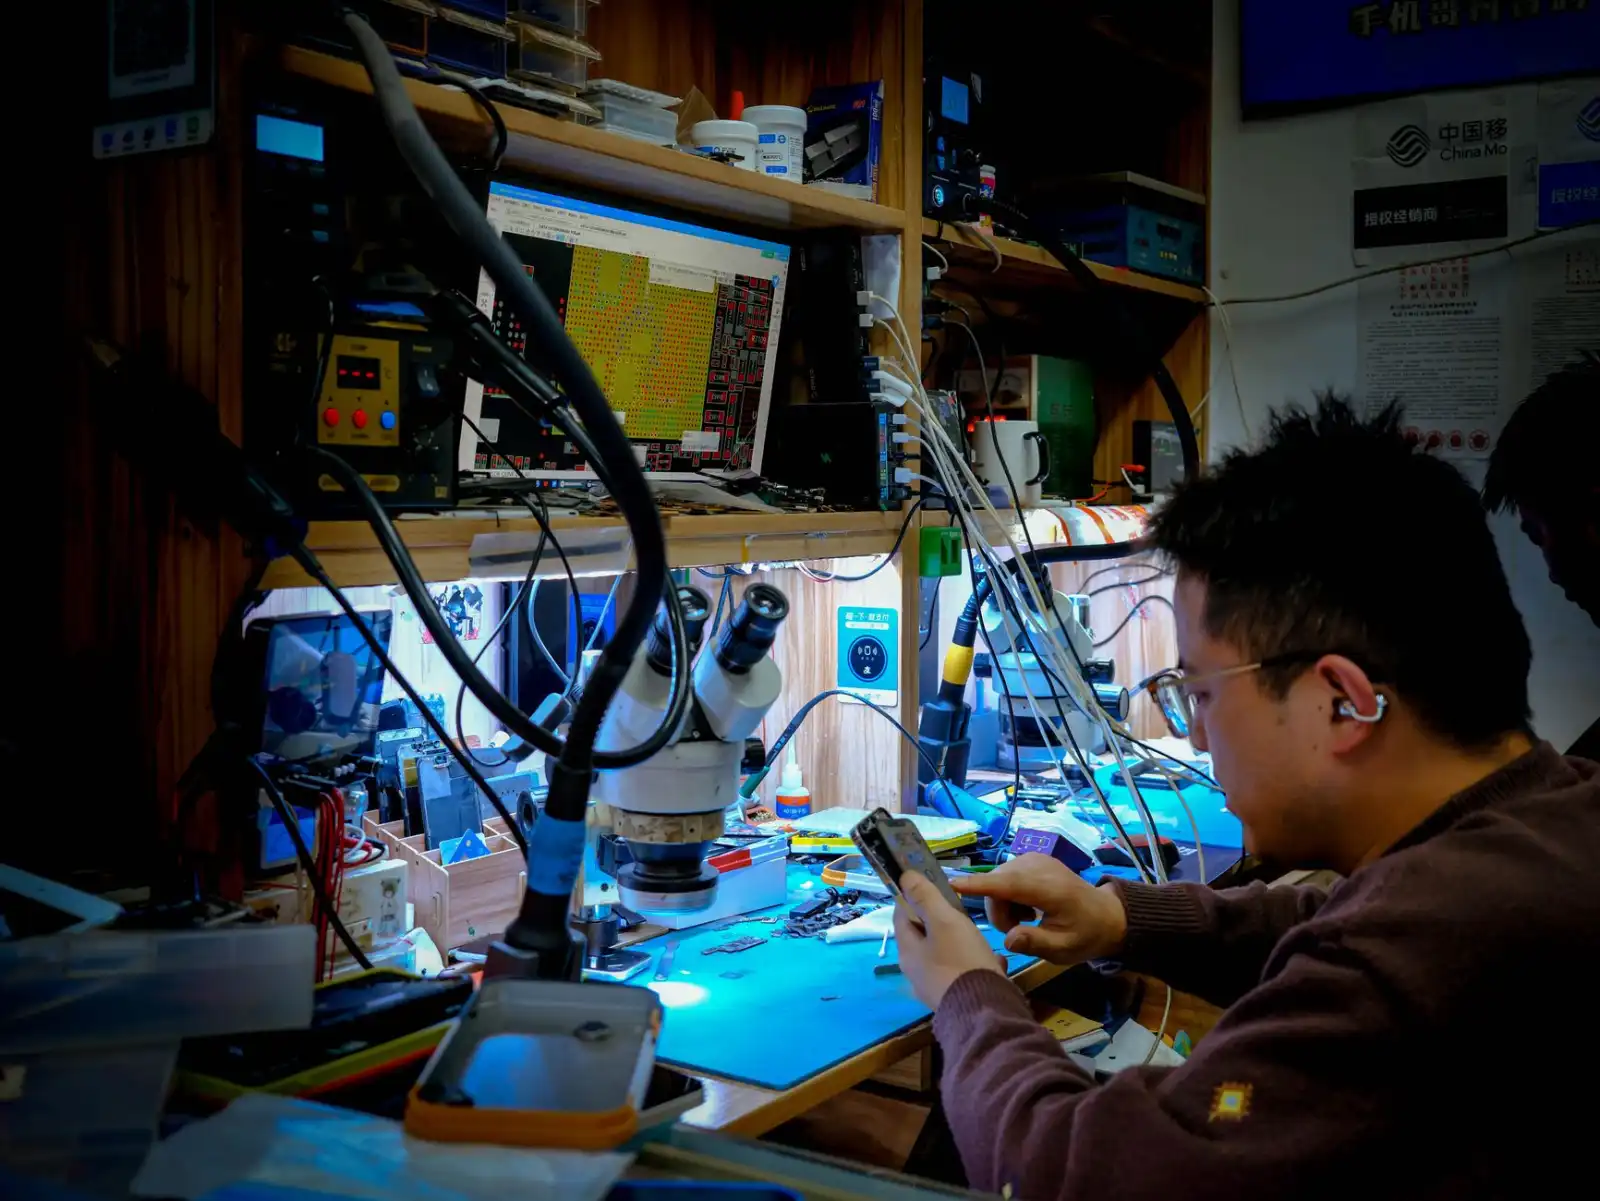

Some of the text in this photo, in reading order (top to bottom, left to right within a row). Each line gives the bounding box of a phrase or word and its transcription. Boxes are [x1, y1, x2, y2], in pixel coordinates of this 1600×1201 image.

[1439, 118, 1507, 144] 中国移
[1440, 143, 1507, 161] China Mo
[1364, 206, 1438, 228] 授权经销商
